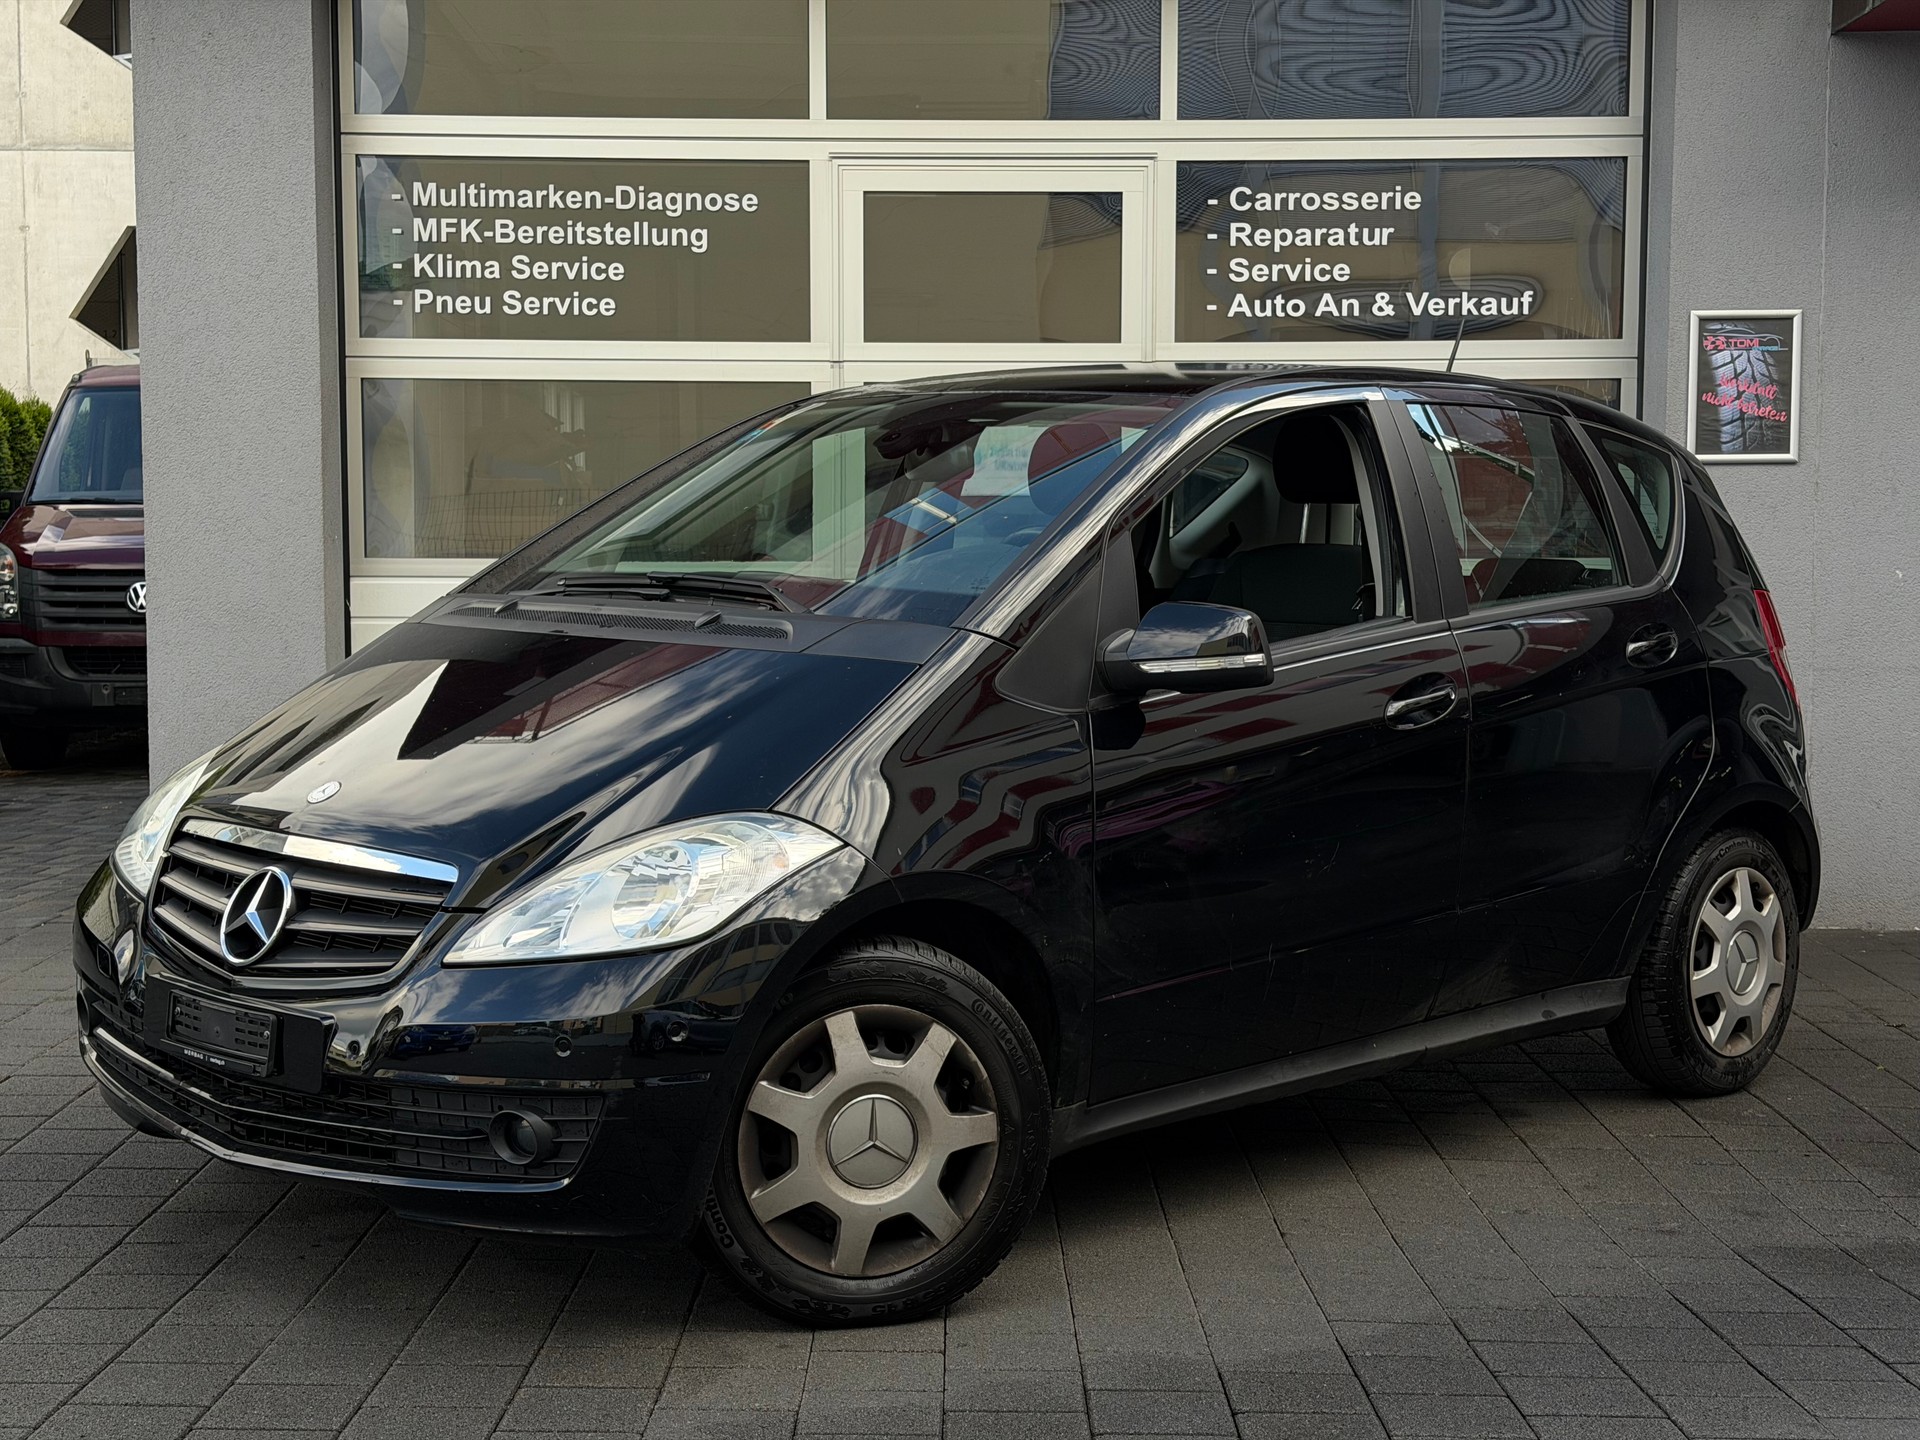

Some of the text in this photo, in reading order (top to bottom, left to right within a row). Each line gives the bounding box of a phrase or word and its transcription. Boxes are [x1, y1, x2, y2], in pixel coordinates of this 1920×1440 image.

[412, 181, 759, 217] Multimarken-Diagnose
[1229, 186, 1422, 211] Carrosserie
[413, 218, 709, 253] MFK-Bereitstellung
[1229, 222, 1395, 252] Reparatur
[413, 253, 501, 279] Klima
[511, 254, 625, 281] Service
[1228, 258, 1351, 283] Service
[414, 288, 491, 315] Pneu
[502, 289, 616, 316] Service
[1227, 293, 1306, 318] Auto
[1314, 292, 1360, 317] An
[1371, 292, 1396, 317] &
[1405, 290, 1534, 316] Verkauf
